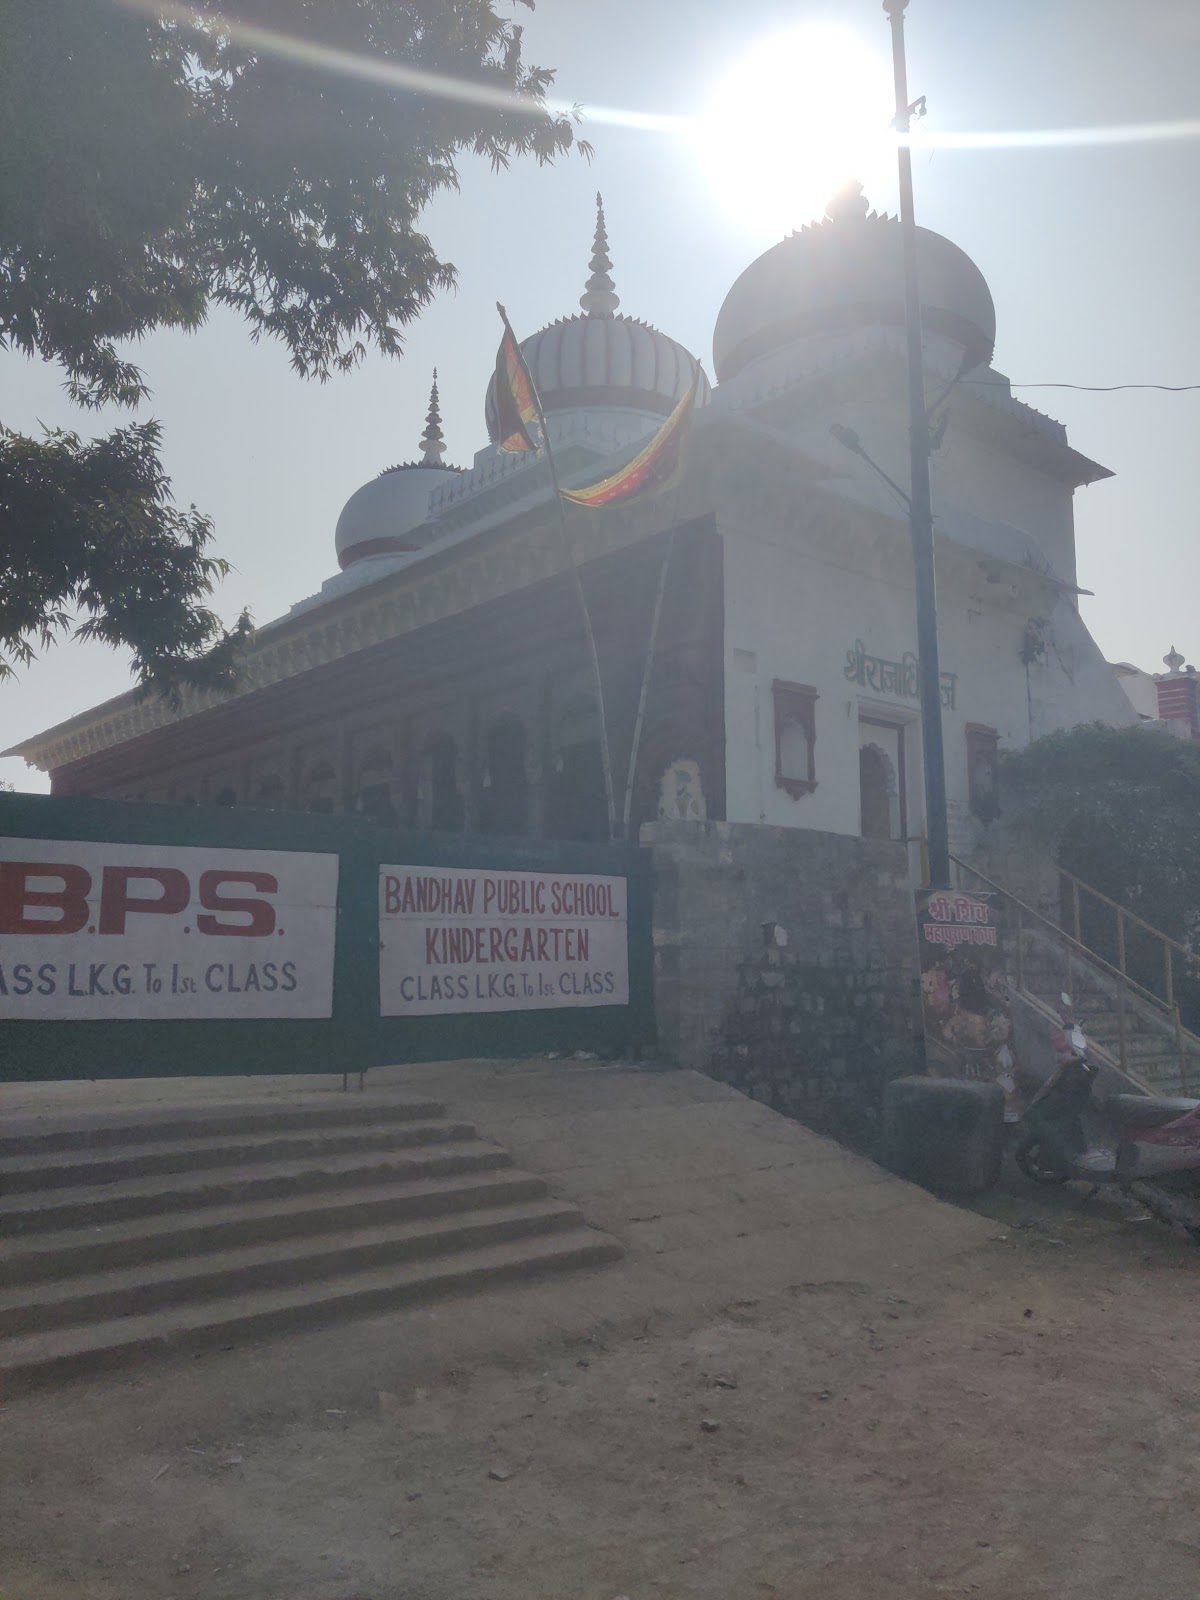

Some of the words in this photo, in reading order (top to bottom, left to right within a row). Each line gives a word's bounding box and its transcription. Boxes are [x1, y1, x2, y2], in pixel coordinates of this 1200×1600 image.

[385, 875, 477, 914] BANDHAV
[483, 879, 545, 914] PUBLIC
[551, 881, 620, 917] SCHOOL
[928, 897, 951, 922] श्री
[953, 898, 988, 923] शिव
[425, 927, 589, 964] KINDERGARTEN
[205, 961, 297, 992] CLASS
[400, 974, 469, 1001] CLASS
[559, 971, 615, 995] CLASS
